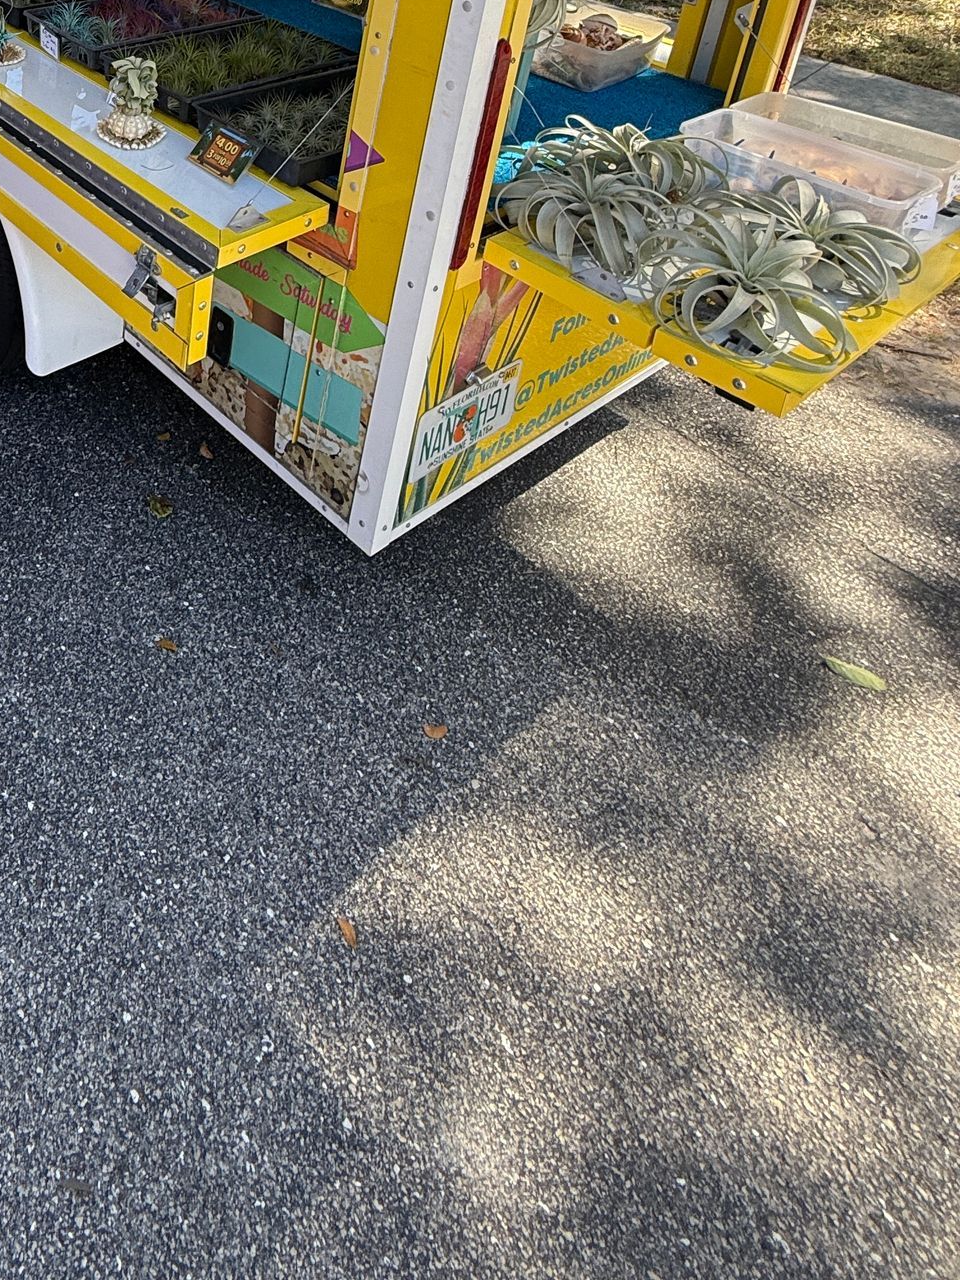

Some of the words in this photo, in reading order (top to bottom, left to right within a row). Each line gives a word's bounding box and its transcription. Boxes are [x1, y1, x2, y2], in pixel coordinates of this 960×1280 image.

[206, 149, 215, 158] 3
[215, 134, 239, 155] $4.00
[280, 273, 352, 334] Saturday
[419, 413, 458, 466] NAN
[476, 384, 510, 426] H91
[433, 439, 467, 466] SUNSHINE
